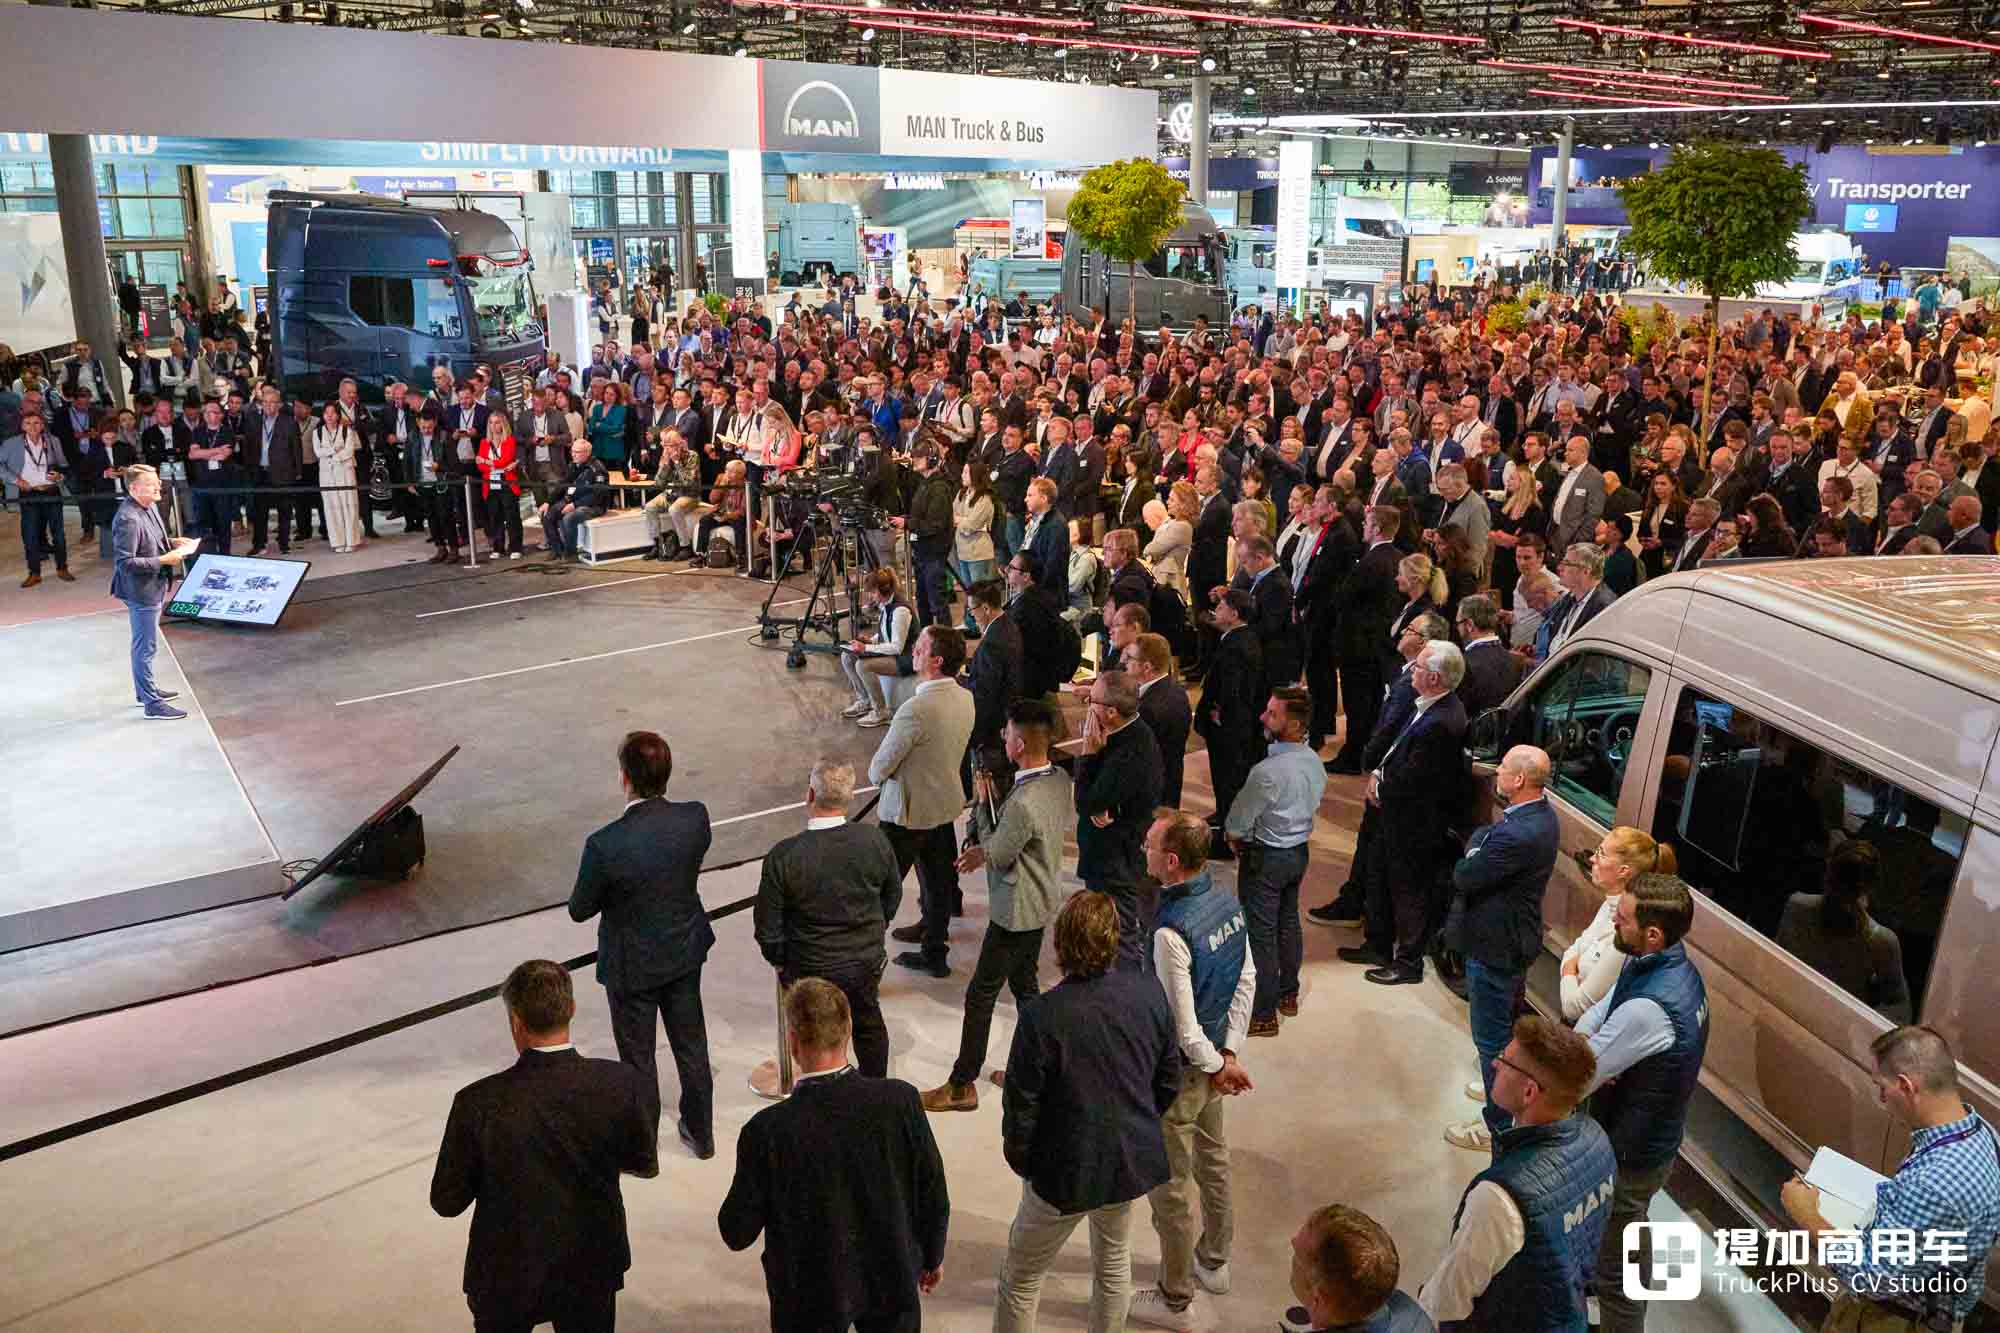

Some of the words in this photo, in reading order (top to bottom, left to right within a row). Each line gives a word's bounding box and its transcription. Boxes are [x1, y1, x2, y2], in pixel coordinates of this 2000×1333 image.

[790, 118, 852, 137] MAN
[906, 115, 946, 139] MAN
[951, 118, 995, 141] Truck
[999, 120, 1012, 141] &
[1016, 121, 1045, 143] Bus
[1827, 177, 1972, 203] Transporter
[171, 603, 199, 615] 03:28
[1208, 911, 1246, 953] MAN
[1563, 1173, 1615, 1235] MAN
